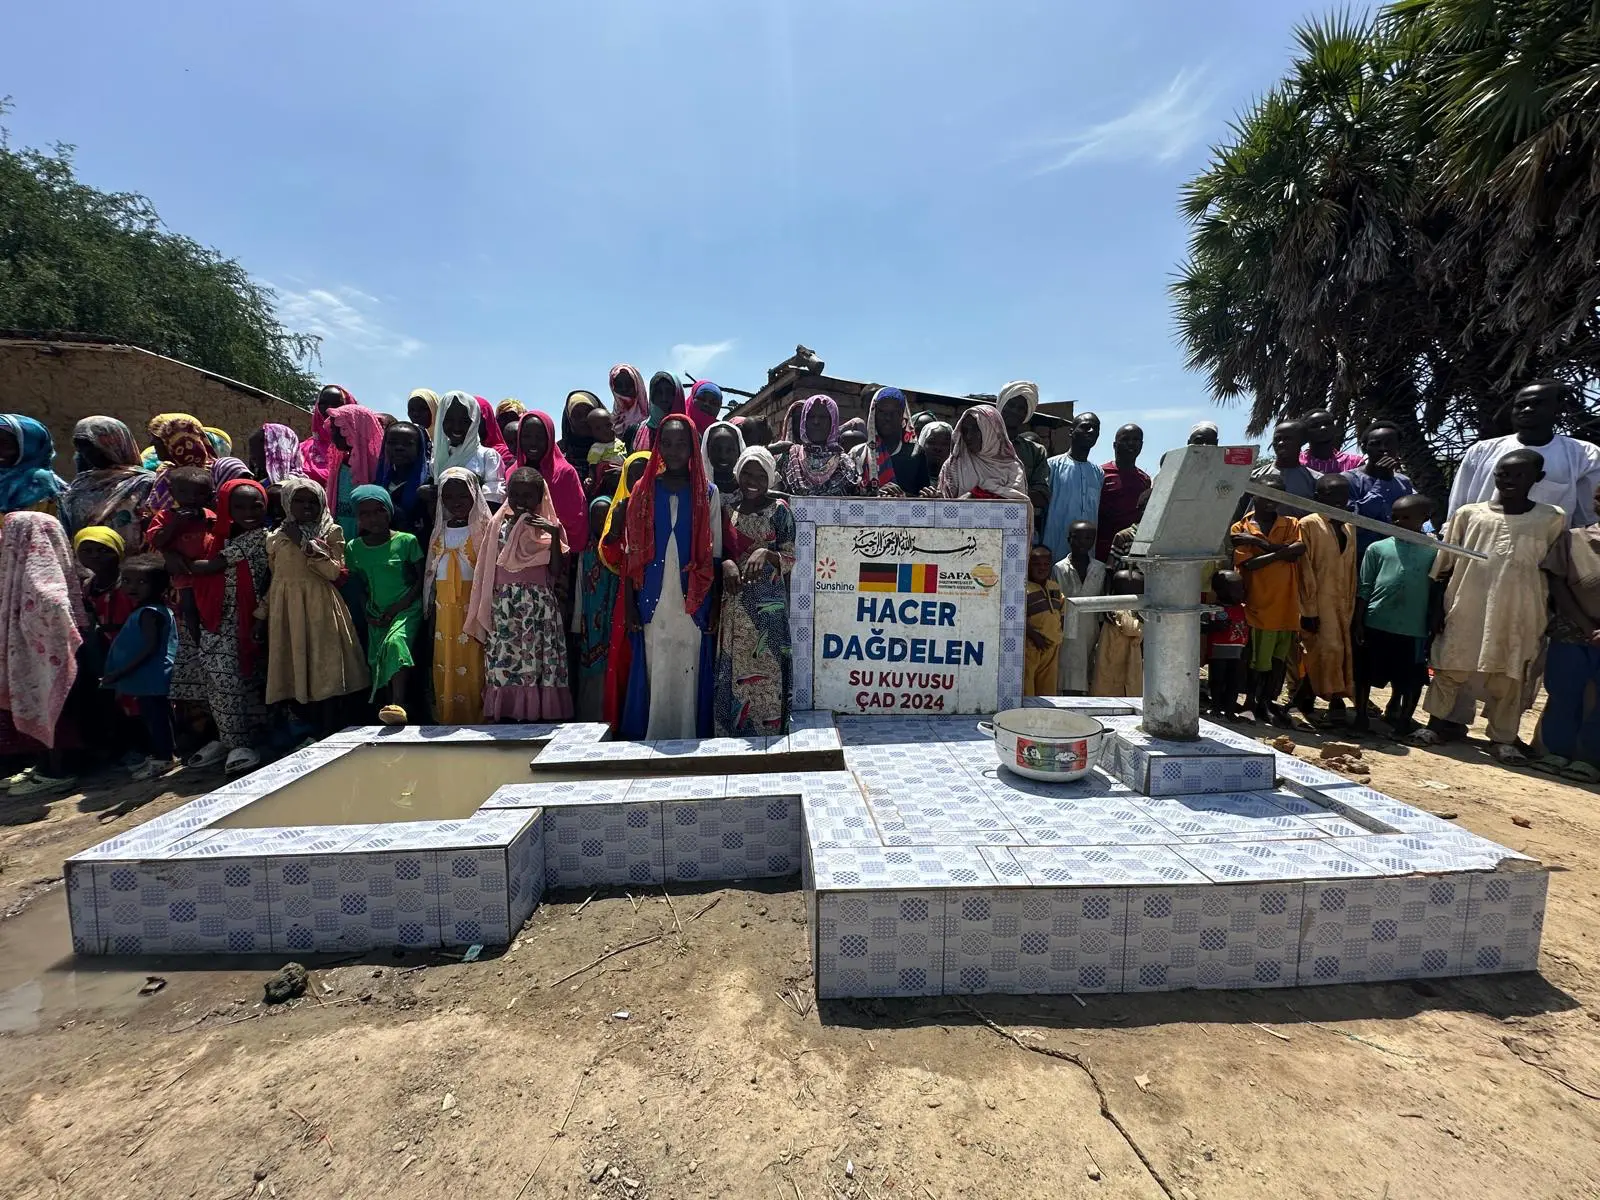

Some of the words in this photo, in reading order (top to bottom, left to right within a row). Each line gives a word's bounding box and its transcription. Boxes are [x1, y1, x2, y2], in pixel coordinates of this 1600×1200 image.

[816, 581, 855, 591] Sunshine
[939, 572, 971, 580] SAFA
[857, 597, 957, 627] HACER
[822, 628, 984, 666] DAĞDELEN
[849, 670, 873, 687] SU
[878, 671, 955, 690] KUYUSU
[856, 691, 895, 712] ÇAD
[900, 693, 945, 711] 2024
